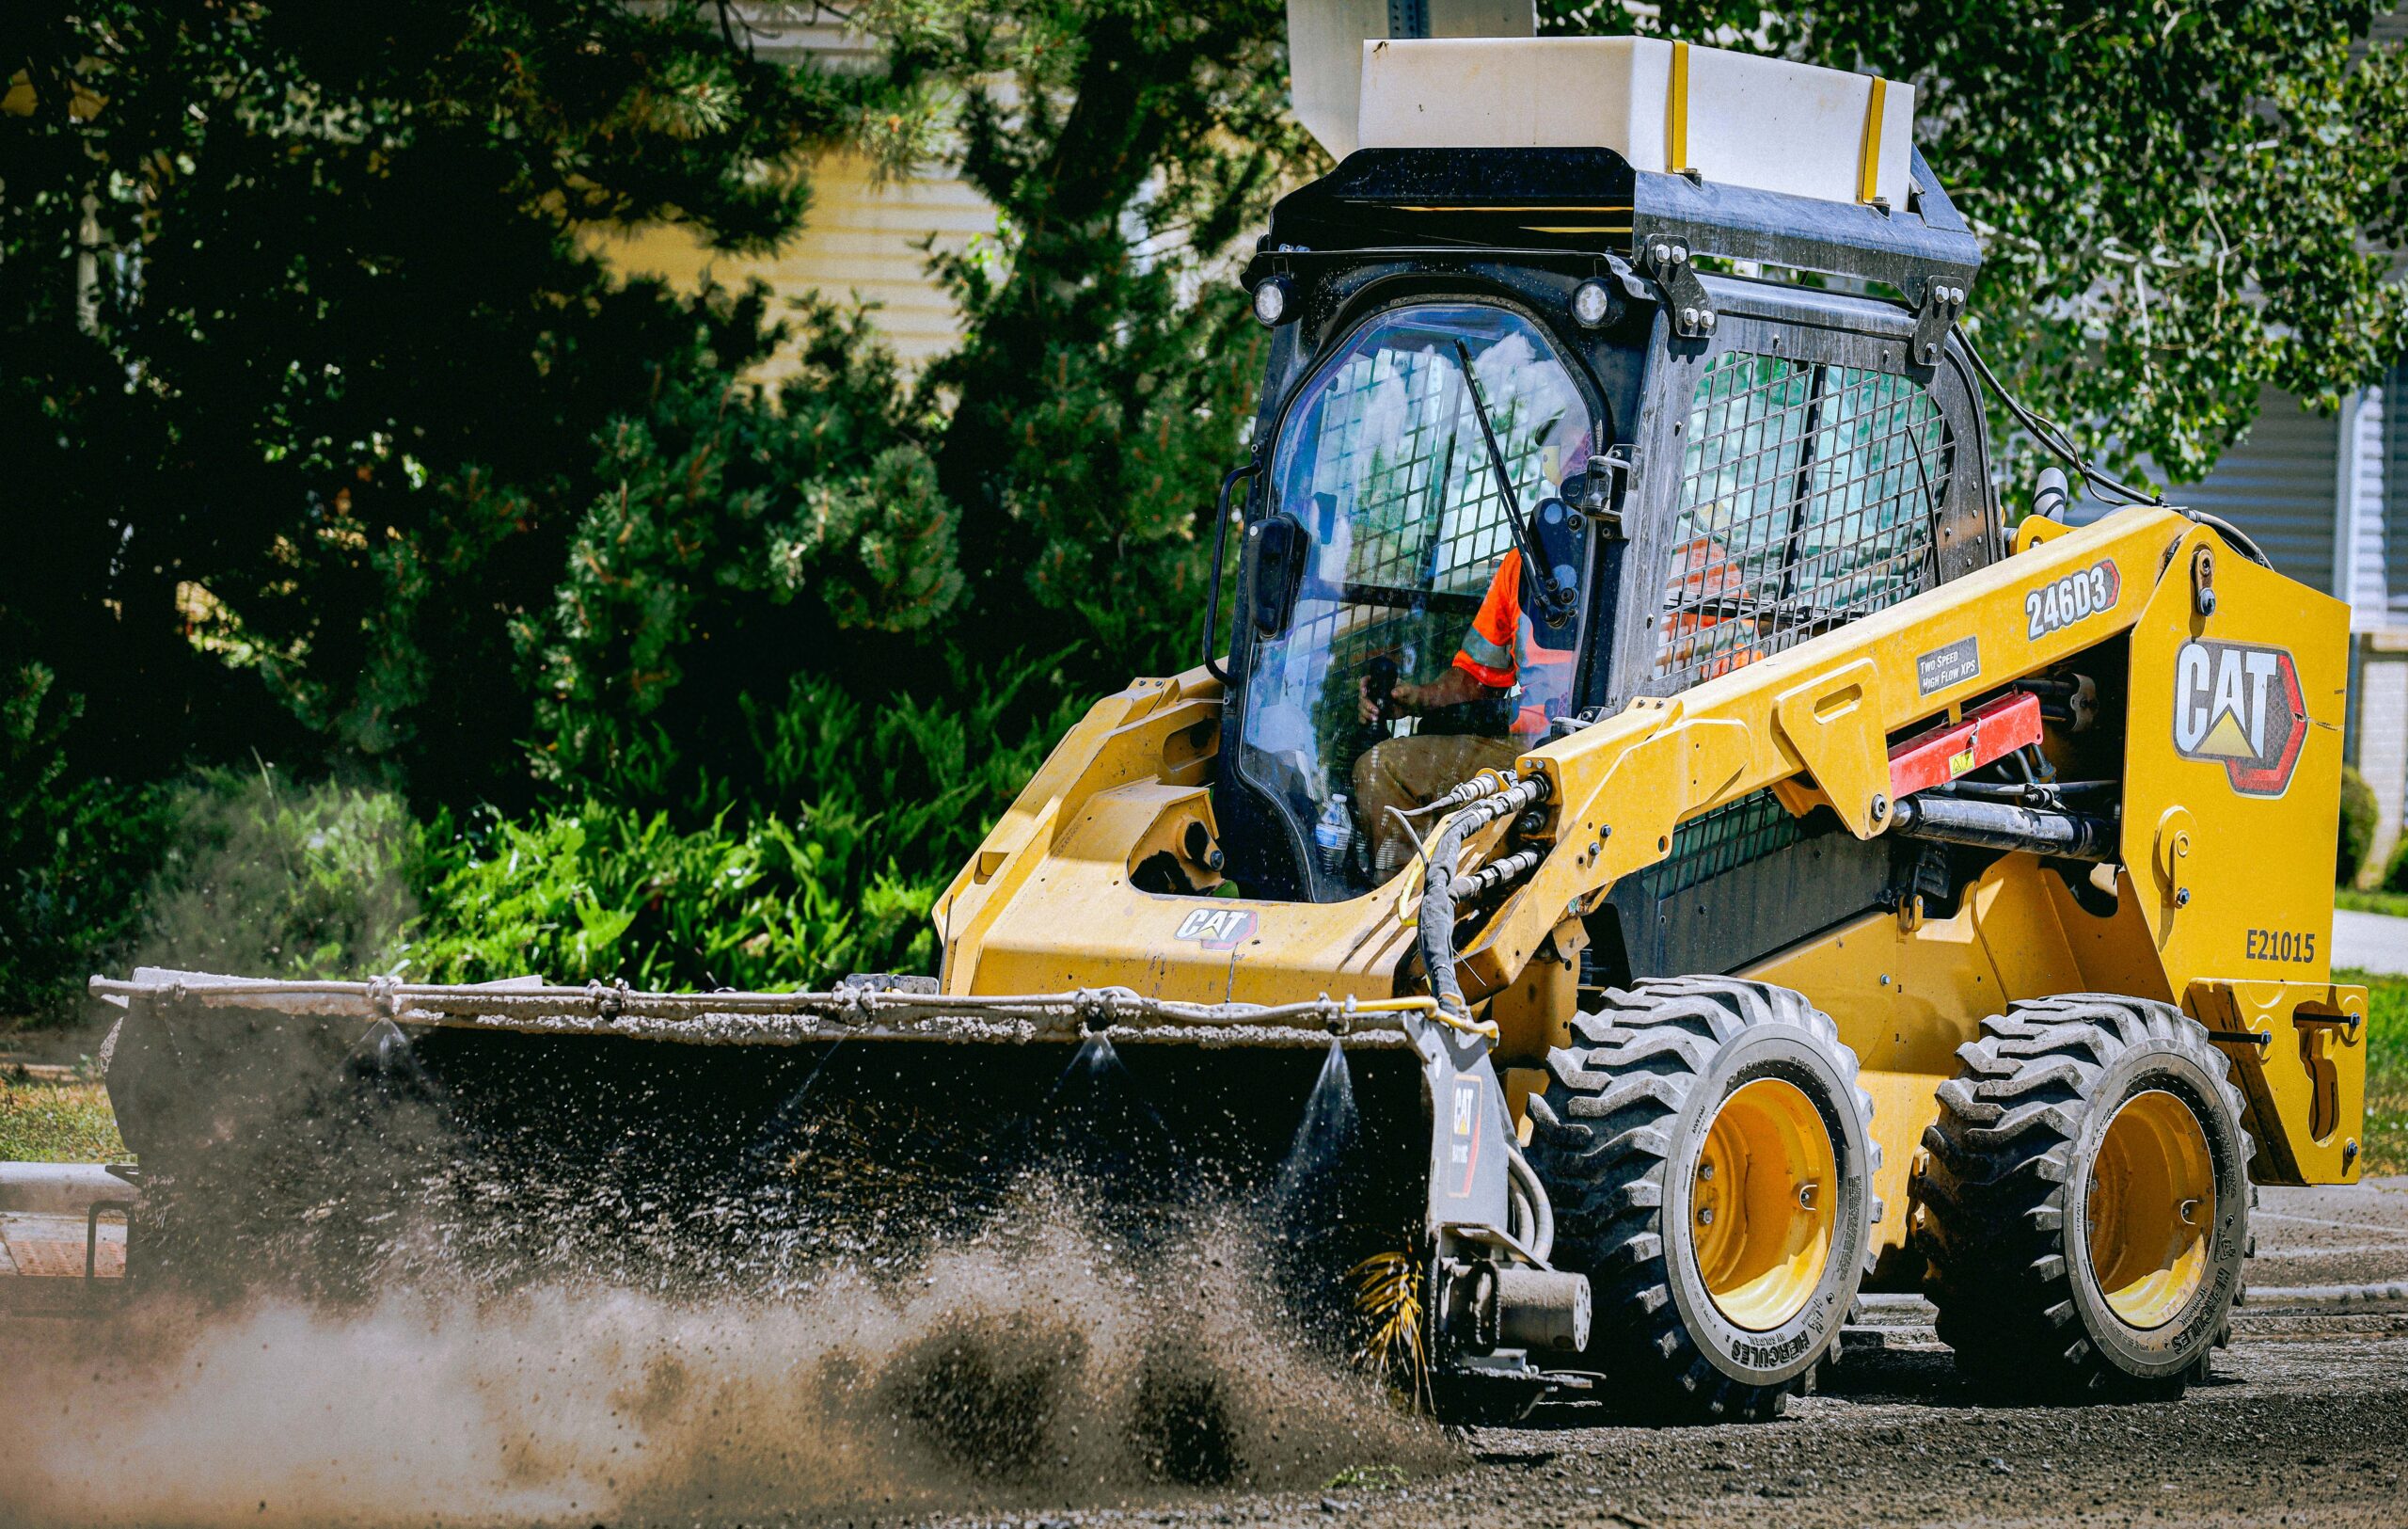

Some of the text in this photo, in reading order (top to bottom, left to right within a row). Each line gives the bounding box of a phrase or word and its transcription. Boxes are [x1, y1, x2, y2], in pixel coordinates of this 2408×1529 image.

[2027, 566, 2107, 638] 246D3
[1961, 660, 1975, 676] XPS
[2176, 644, 2277, 758] CAT
[1177, 909, 1249, 941] CAT
[2246, 930, 2315, 964] E21015
[1453, 1087, 1474, 1135] CAT
[2171, 1267, 2231, 1354] HERCULES
[1731, 1330, 1811, 1368] HERCULES
